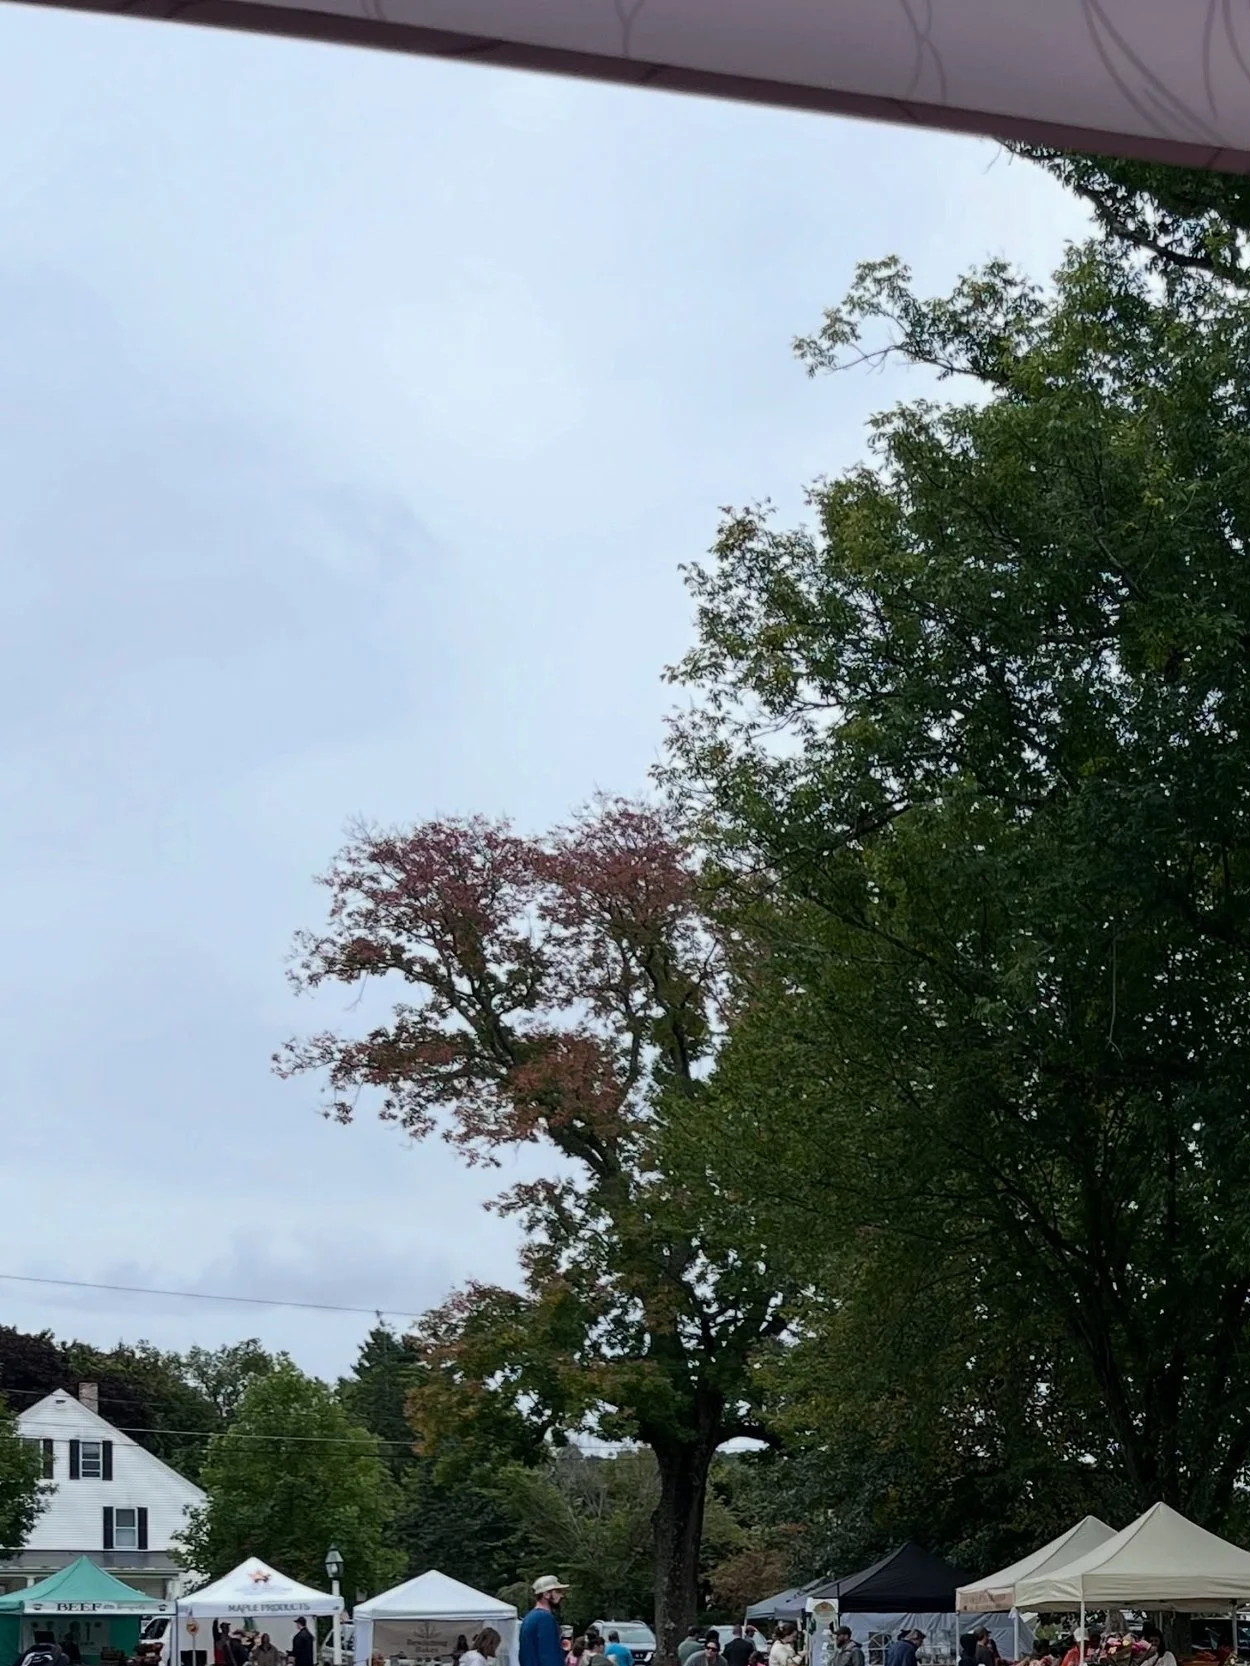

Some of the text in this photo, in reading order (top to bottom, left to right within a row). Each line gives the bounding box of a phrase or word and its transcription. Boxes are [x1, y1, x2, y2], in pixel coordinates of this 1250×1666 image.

[56, 1602, 102, 1613] BEEF
[227, 1601, 311, 1614] MAPLE PRODUCTS
